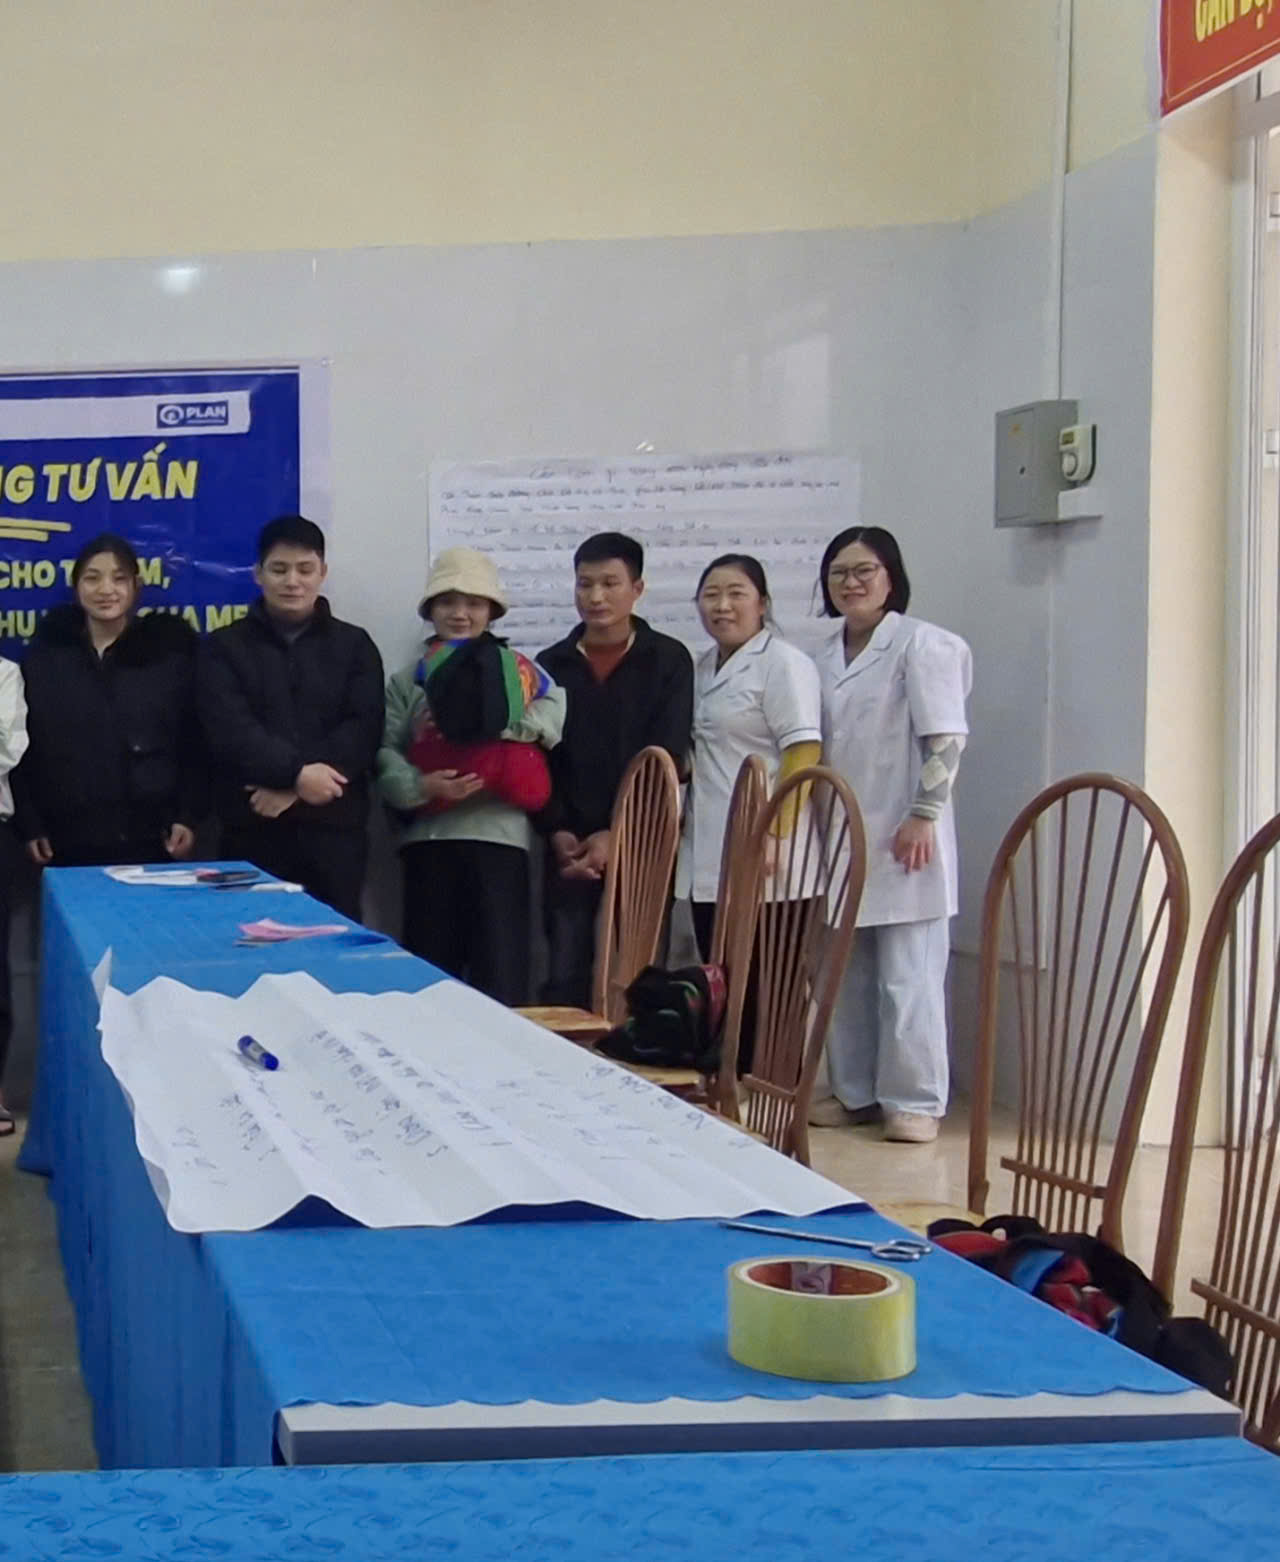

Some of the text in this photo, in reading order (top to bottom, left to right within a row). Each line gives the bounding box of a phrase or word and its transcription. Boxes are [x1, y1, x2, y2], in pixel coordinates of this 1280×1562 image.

[186, 405, 226, 419] PLAN
[42, 457, 102, 503] TƯ
[105, 441, 199, 501] VẤN
